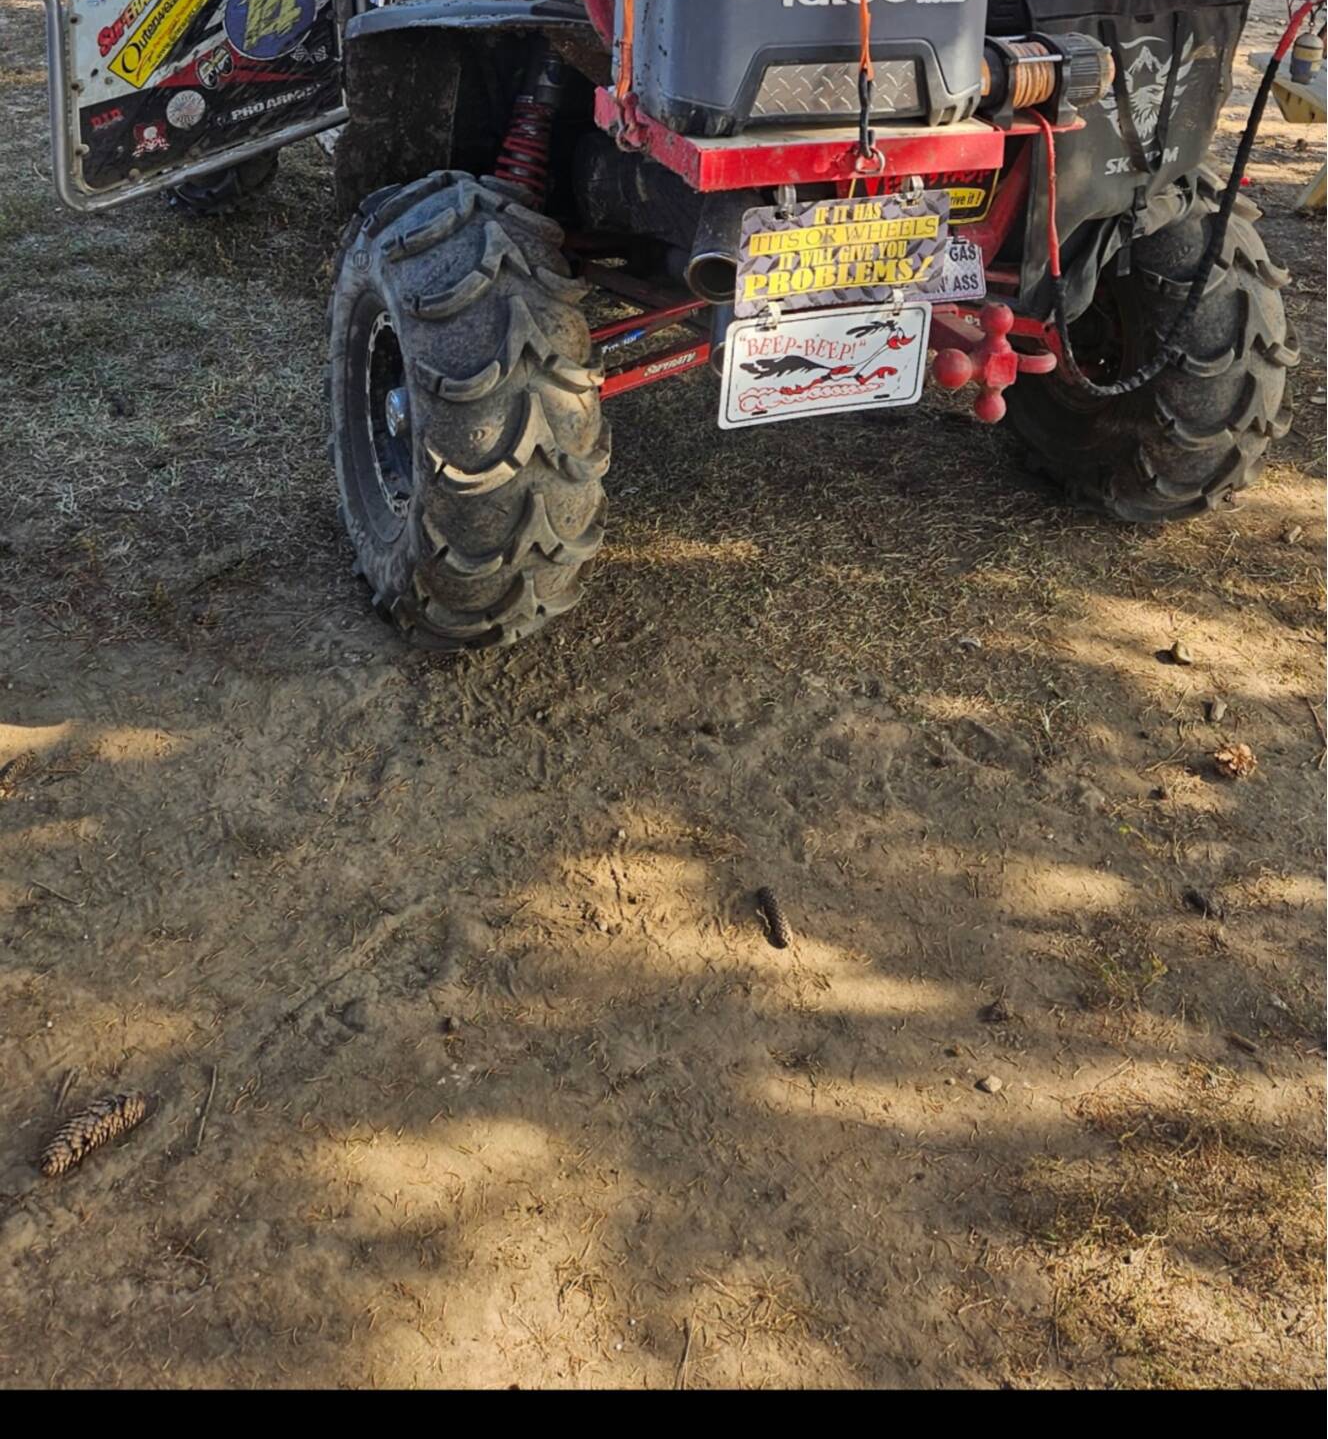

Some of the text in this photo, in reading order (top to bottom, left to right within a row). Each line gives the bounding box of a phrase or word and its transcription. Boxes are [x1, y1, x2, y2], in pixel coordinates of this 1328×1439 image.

[231, 102, 265, 121] PRO
[950, 195, 966, 207] rive
[813, 202, 882, 224] IF IT HAS
[753, 217, 937, 251] TITS OR WHEELS
[778, 240, 908, 270] IT WILL GIVE YOU
[949, 245, 977, 262] GAS
[742, 256, 935, 301] PROBLEMS!
[953, 275, 980, 292] ASS
